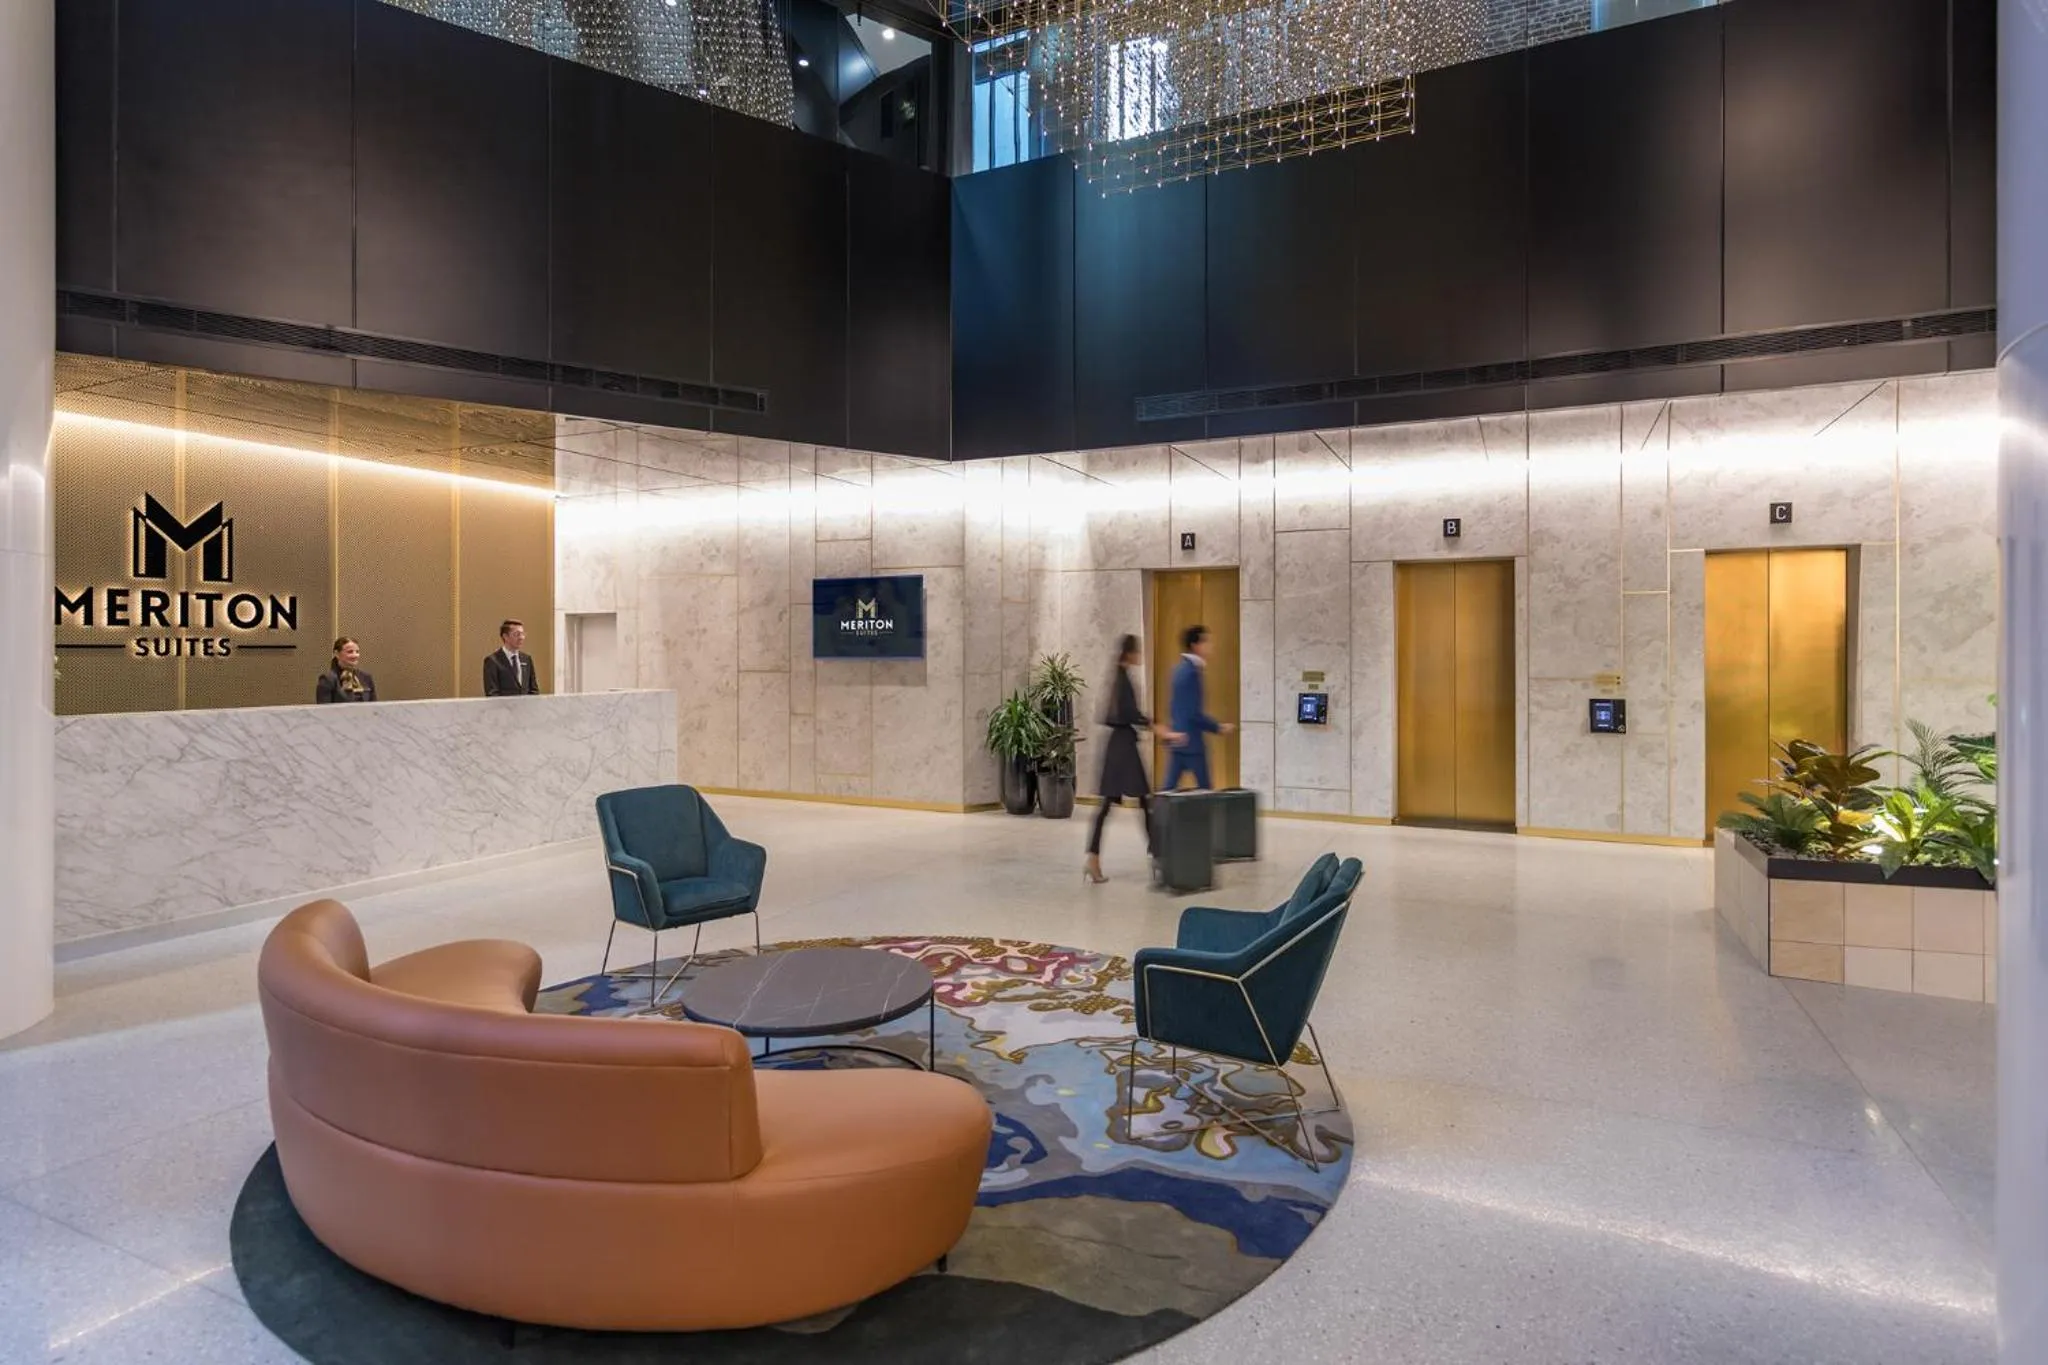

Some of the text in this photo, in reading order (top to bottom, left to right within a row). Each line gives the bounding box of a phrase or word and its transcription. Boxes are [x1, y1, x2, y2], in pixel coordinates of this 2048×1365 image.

[1776, 505, 1786, 520] C
[1447, 521, 1456, 535] B
[1184, 535, 1192, 546] A
[55, 586, 297, 631] MERITON
[840, 619, 894, 630] MERITON
[135, 637, 232, 657] SUITES
